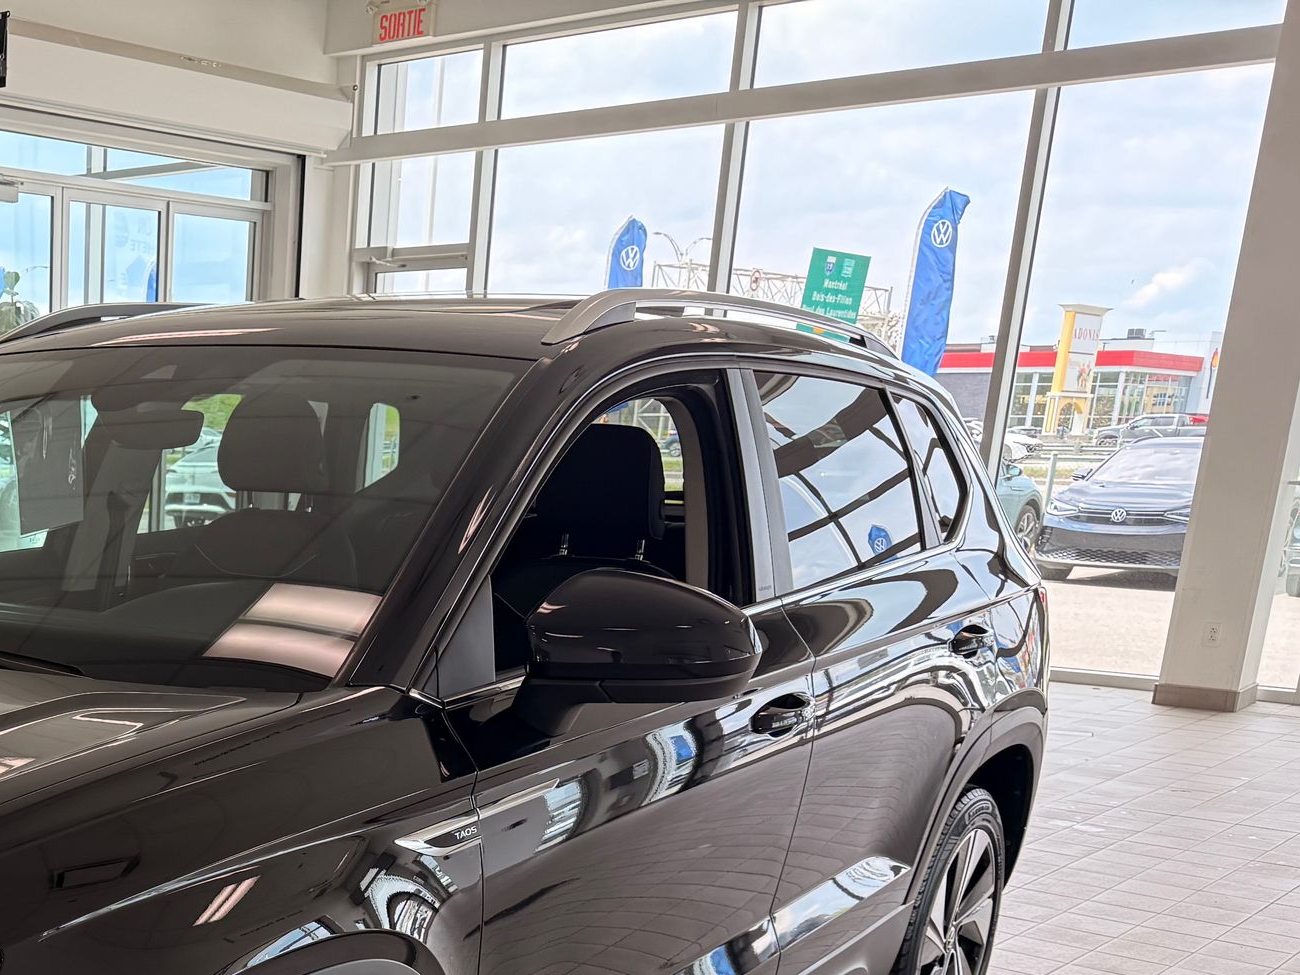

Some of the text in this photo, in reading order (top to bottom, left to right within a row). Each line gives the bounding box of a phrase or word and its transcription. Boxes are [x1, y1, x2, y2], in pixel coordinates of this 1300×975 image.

[380, 8, 426, 42] SORTIE
[1074, 327, 1100, 341] ADONIS
[454, 825, 478, 840] TAOS
